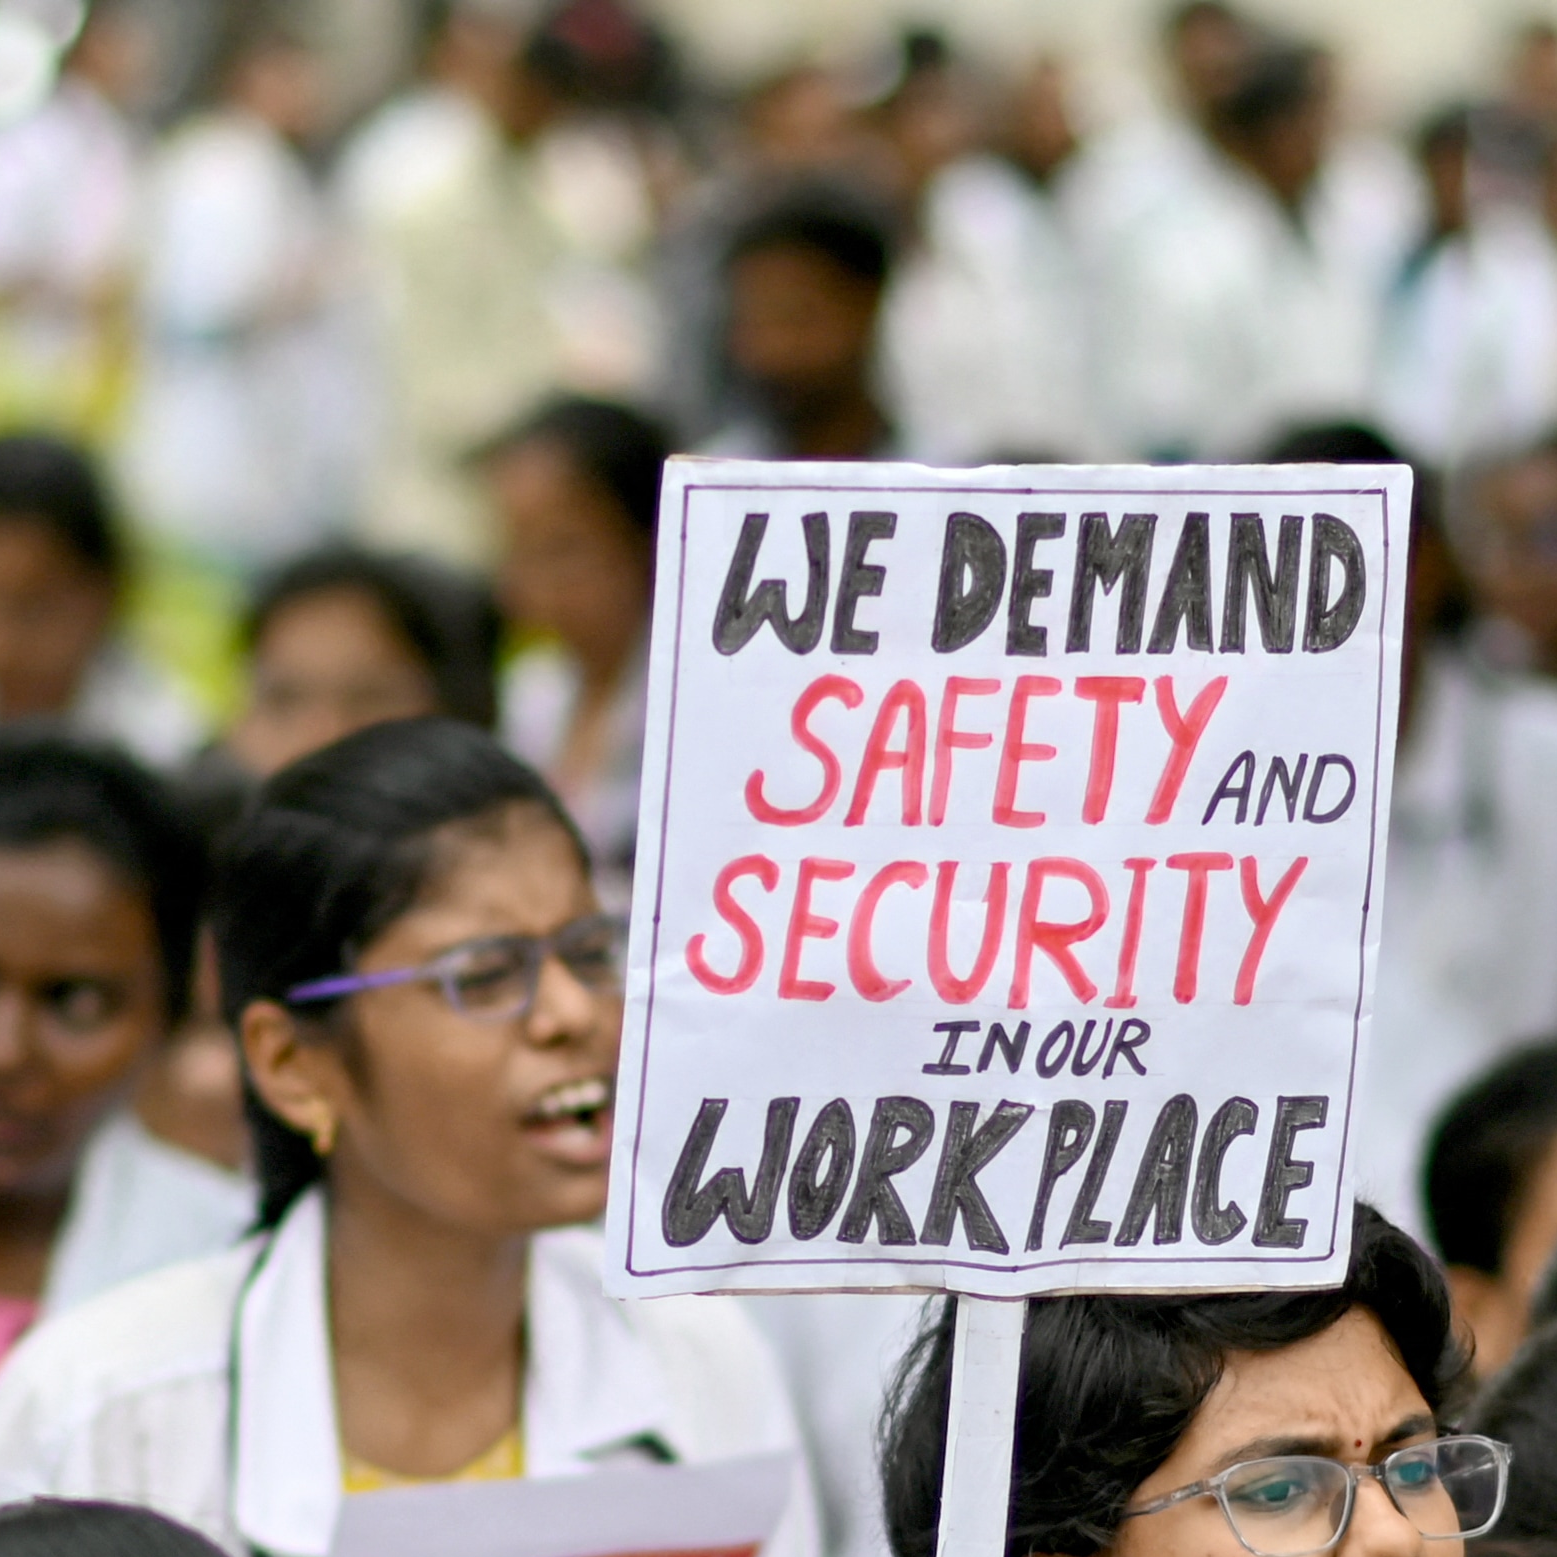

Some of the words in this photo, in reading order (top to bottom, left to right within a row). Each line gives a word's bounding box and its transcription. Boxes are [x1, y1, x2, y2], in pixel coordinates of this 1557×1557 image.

[711, 511, 898, 656] WE
[930, 511, 1367, 656] DEMAND
[744, 673, 1229, 829] SAFETY
[1200, 749, 1357, 825] AND
[684, 851, 1309, 1009] SECURITY
[922, 1020, 1030, 1075] IN
[1035, 1017, 1151, 1078] OUR
[661, 1094, 1329, 1253] WORKPLACE
